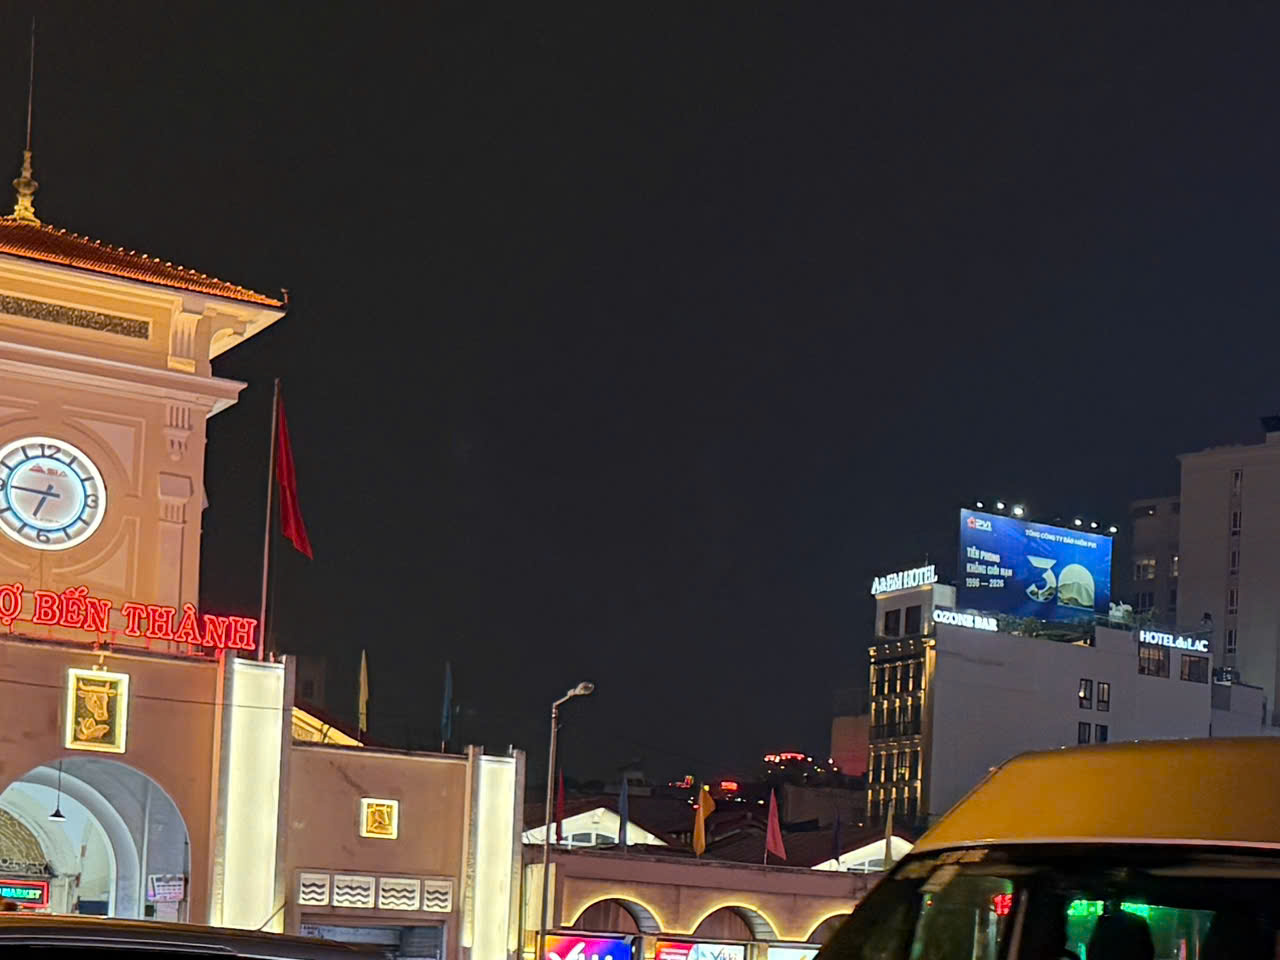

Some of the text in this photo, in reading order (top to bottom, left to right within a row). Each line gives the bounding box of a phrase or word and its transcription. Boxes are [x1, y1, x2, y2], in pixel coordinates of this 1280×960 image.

[903, 564, 938, 588] HOTEL
[122, 602, 258, 650] THÀNH
[1140, 630, 1176, 647] HOTEL
[1188, 637, 1209, 653] LAC
